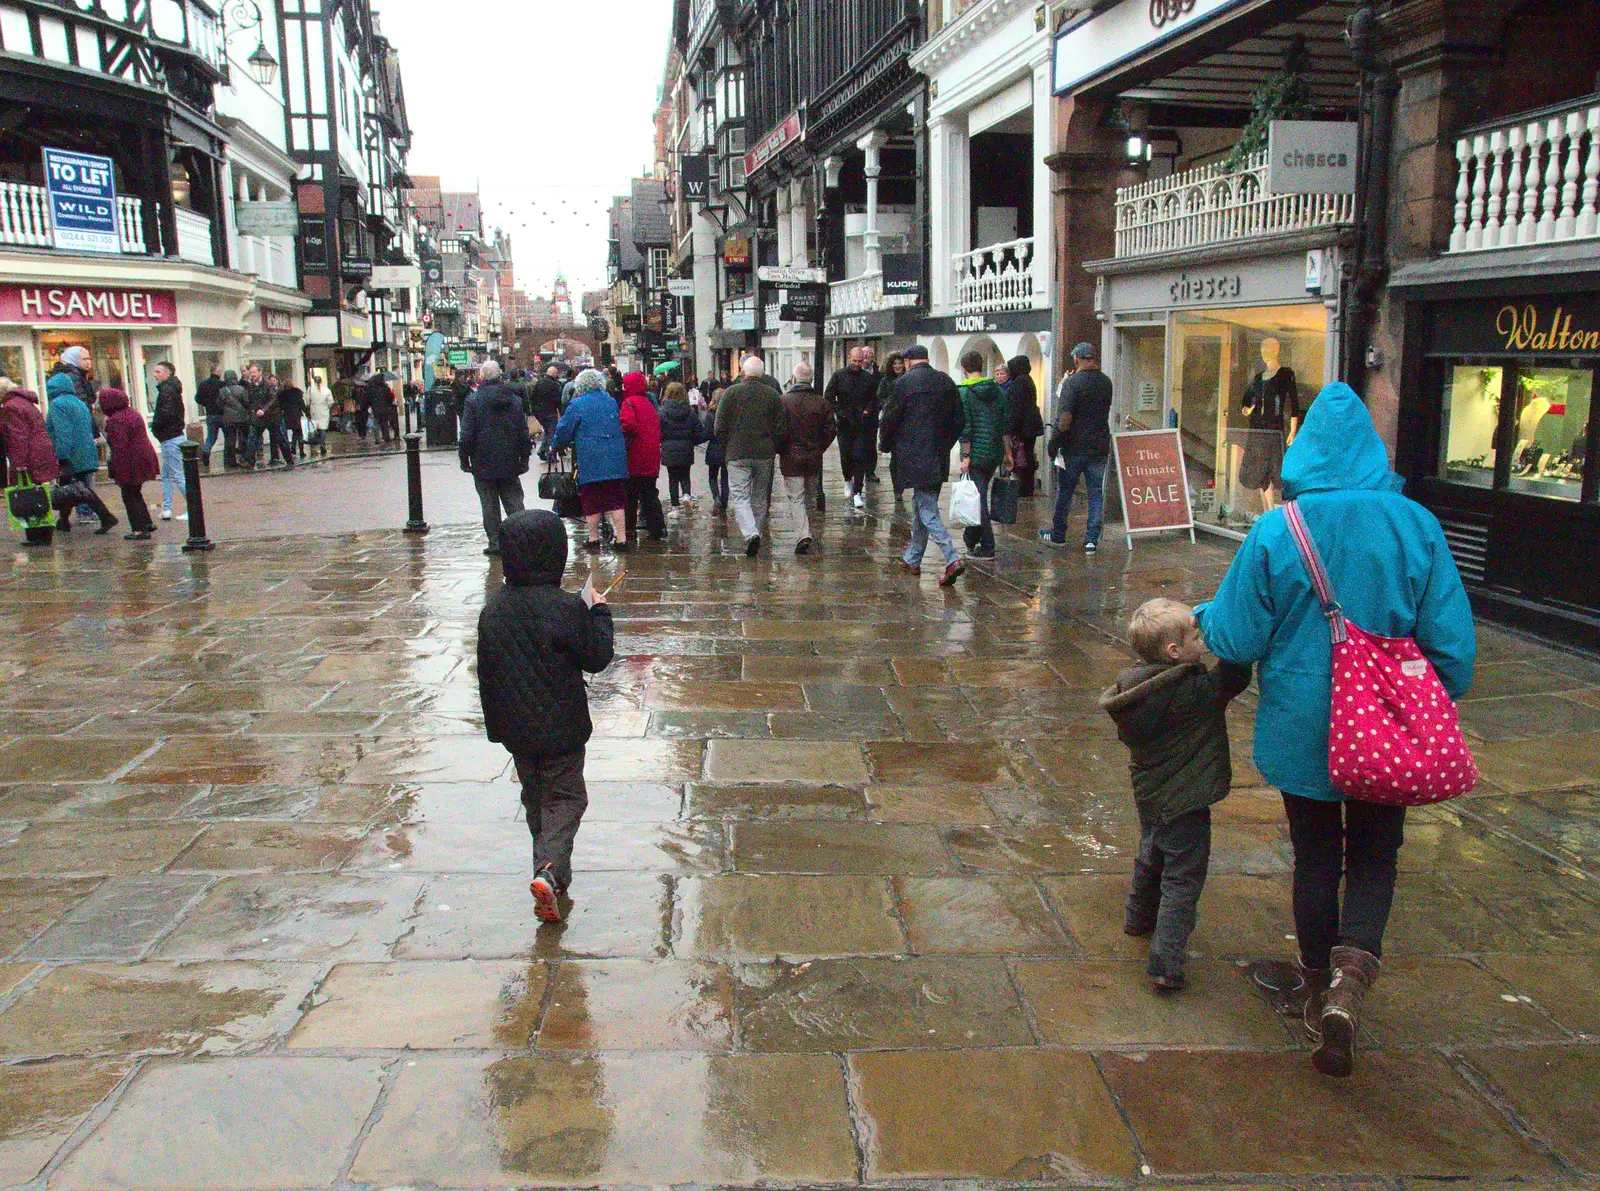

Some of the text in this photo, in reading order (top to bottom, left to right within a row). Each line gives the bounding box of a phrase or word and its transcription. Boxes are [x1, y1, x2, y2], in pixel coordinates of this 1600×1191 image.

[1283, 150, 1347, 168] chesca
[50, 162, 110, 187] TO LET
[687, 181, 704, 194] W
[59, 202, 109, 216] WILD
[887, 280, 918, 289] KUONI
[1169, 273, 1241, 303] chesca
[21, 289, 162, 319] H SAMUEL
[664, 298, 673, 326] Pykes
[842, 315, 868, 335] JONES
[955, 315, 985, 332] KUONI
[1136, 449, 1161, 461] The
[1125, 465, 1177, 478] Ultimate
[1130, 484, 1180, 505] SALE
